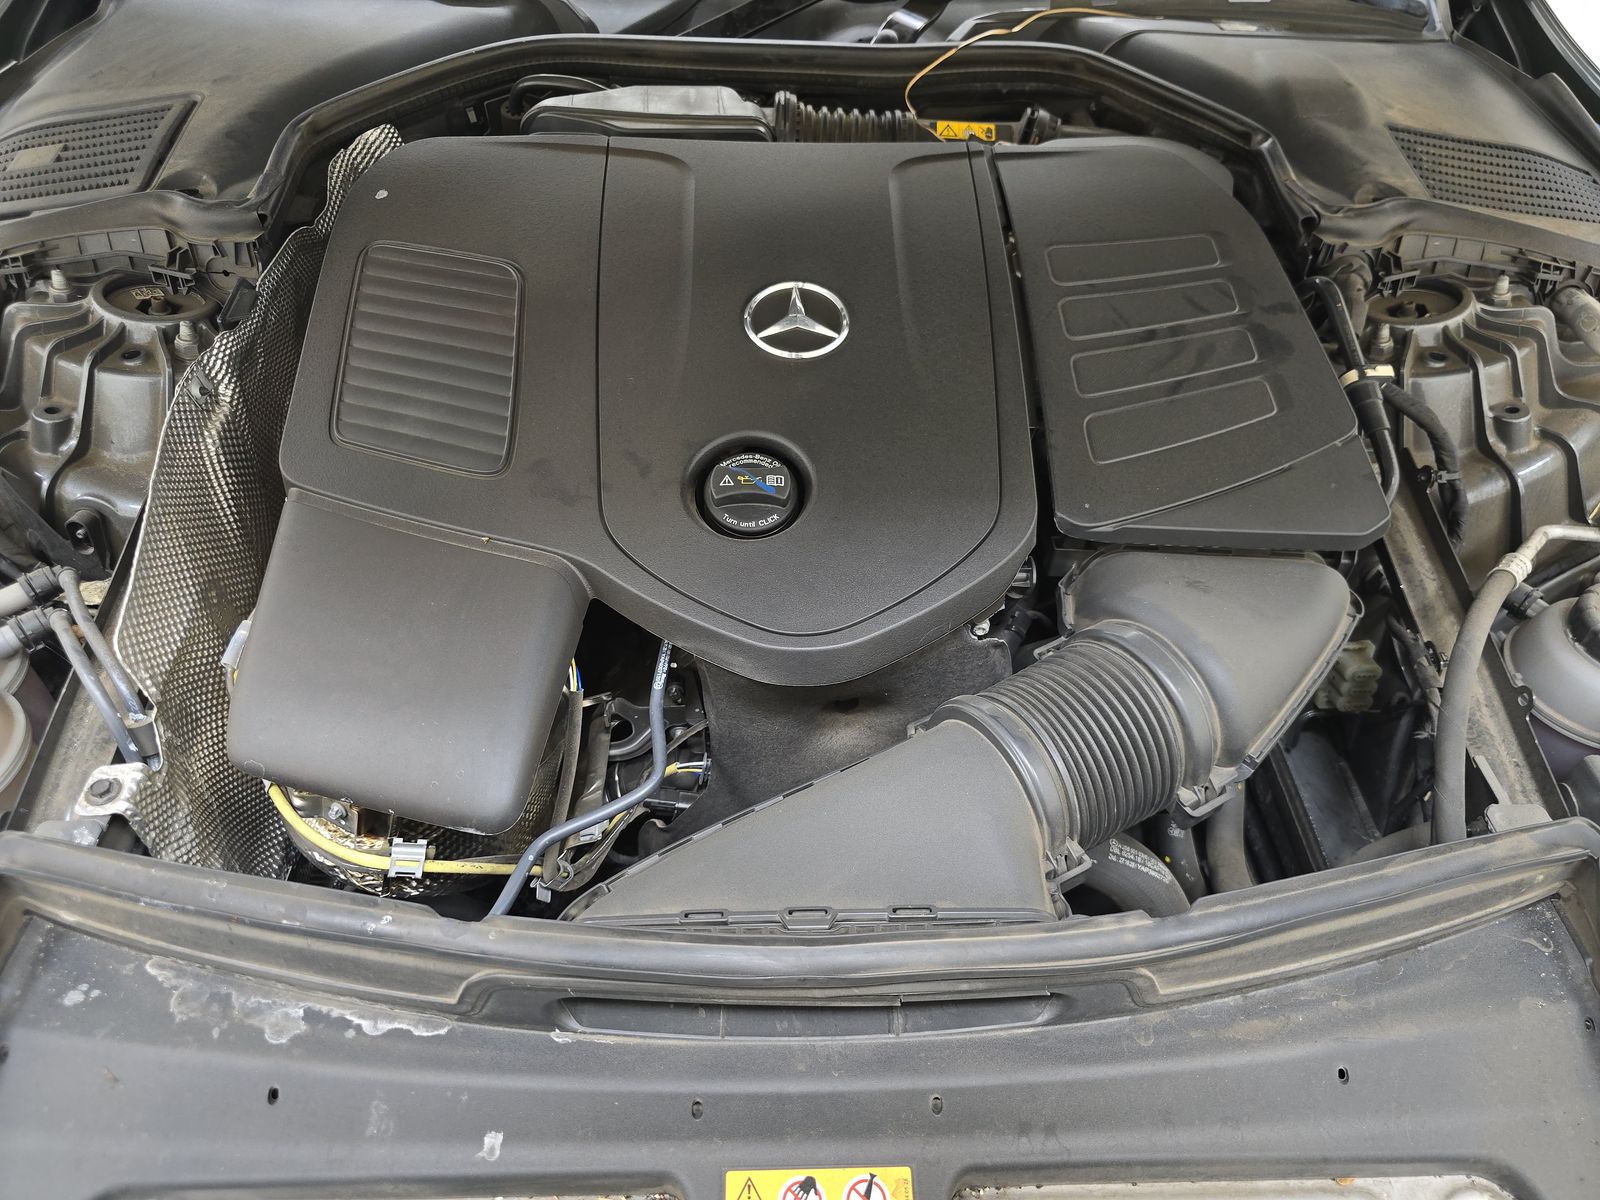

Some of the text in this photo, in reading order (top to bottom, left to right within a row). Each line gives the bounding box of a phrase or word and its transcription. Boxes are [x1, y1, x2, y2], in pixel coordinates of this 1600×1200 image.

[720, 454, 772, 467] Mercedes-Benz
[722, 513, 738, 525] Turn
[758, 513, 780, 527] CLICK
